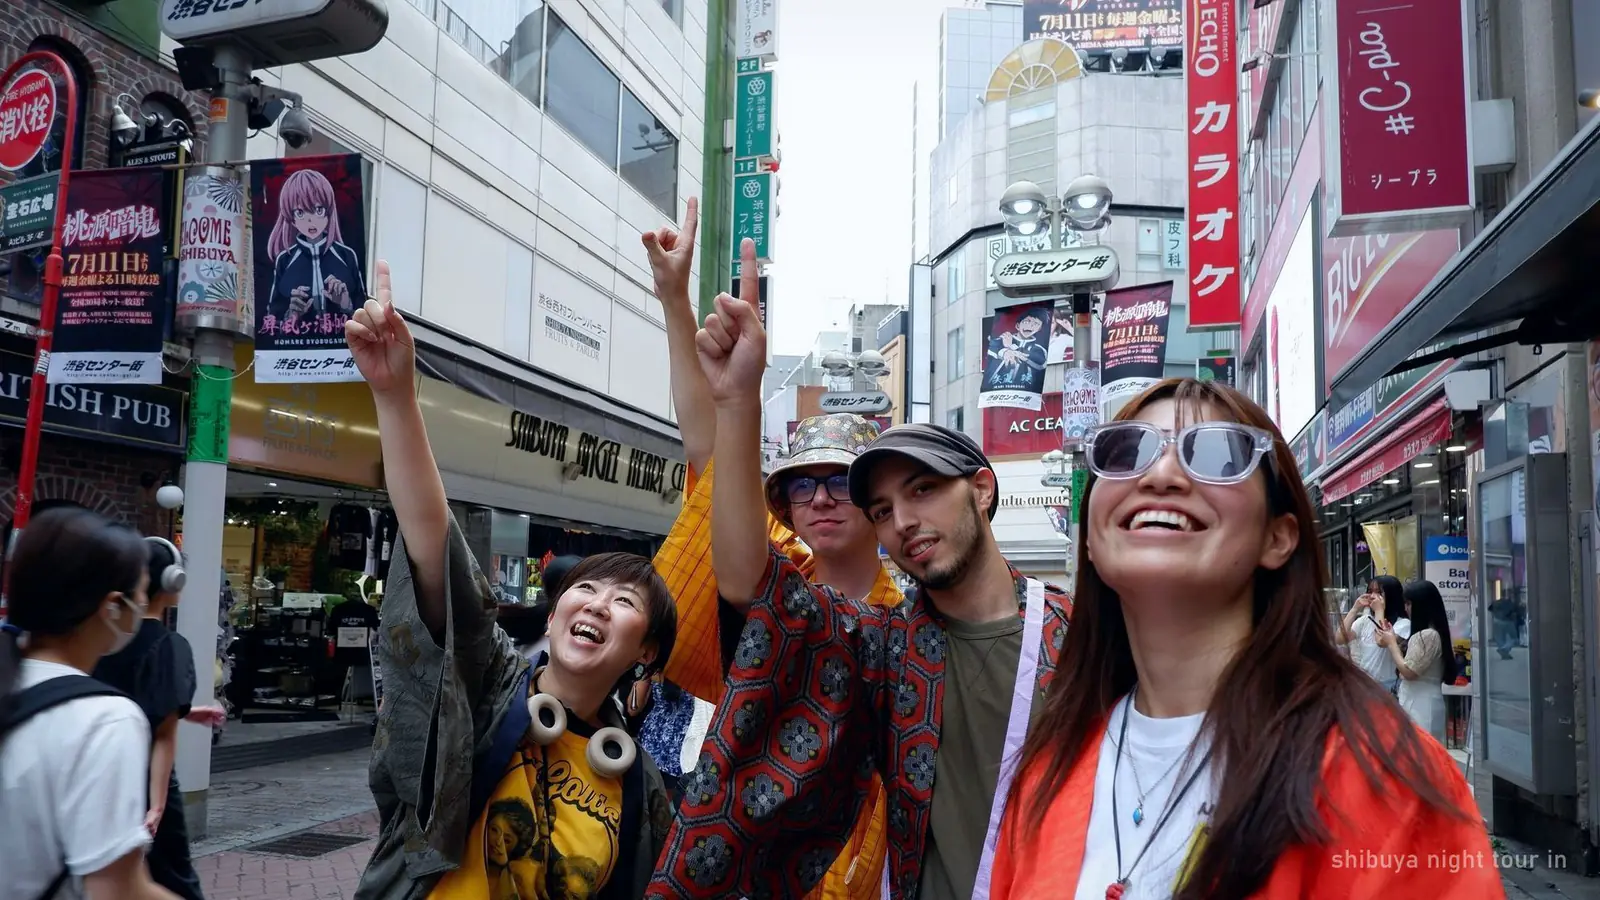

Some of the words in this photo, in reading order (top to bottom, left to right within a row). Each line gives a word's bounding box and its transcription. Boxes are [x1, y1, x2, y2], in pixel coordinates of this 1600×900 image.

[1195, 8, 1220, 77] ECHO
[741, 62, 757, 71] 2F
[6, 90, 19, 103] FIRE
[20, 79, 47, 98] HYDRANT
[0, 94, 49, 144] 消火栓
[126, 156, 143, 166] ALES
[149, 152, 176, 163] STOUTS
[739, 162, 754, 172] 1F
[6, 193, 53, 220] 宝石広場
[1192, 101, 1234, 297] カラオケ
[181, 216, 231, 247] LCOME
[752, 200, 764, 246] 渋谷西村
[1168, 221, 1181, 266] 皮フ科
[181, 246, 237, 265] SHIBUYA
[1000, 255, 1109, 276] 渋谷センター街
[538, 292, 607, 334] 渋谷西村フルーツパーラー
[545, 326, 568, 346] FRUITS
[576, 342, 600, 361] PARLOR
[63, 360, 145, 372] 渋谷センター街
[273, 357, 354, 370] 渋谷センター街
[986, 394, 1032, 402] 渋谷センター街
[1106, 382, 1151, 395] 渋谷センター街
[111, 394, 171, 428] PUB
[823, 395, 884, 407] 渋谷センター街
[1067, 406, 1099, 415] SHIBUYA
[1009, 418, 1030, 433] AC
[505, 410, 569, 462] SHIBUYA
[576, 432, 621, 483] ANGEL
[626, 448, 668, 493] HEART
